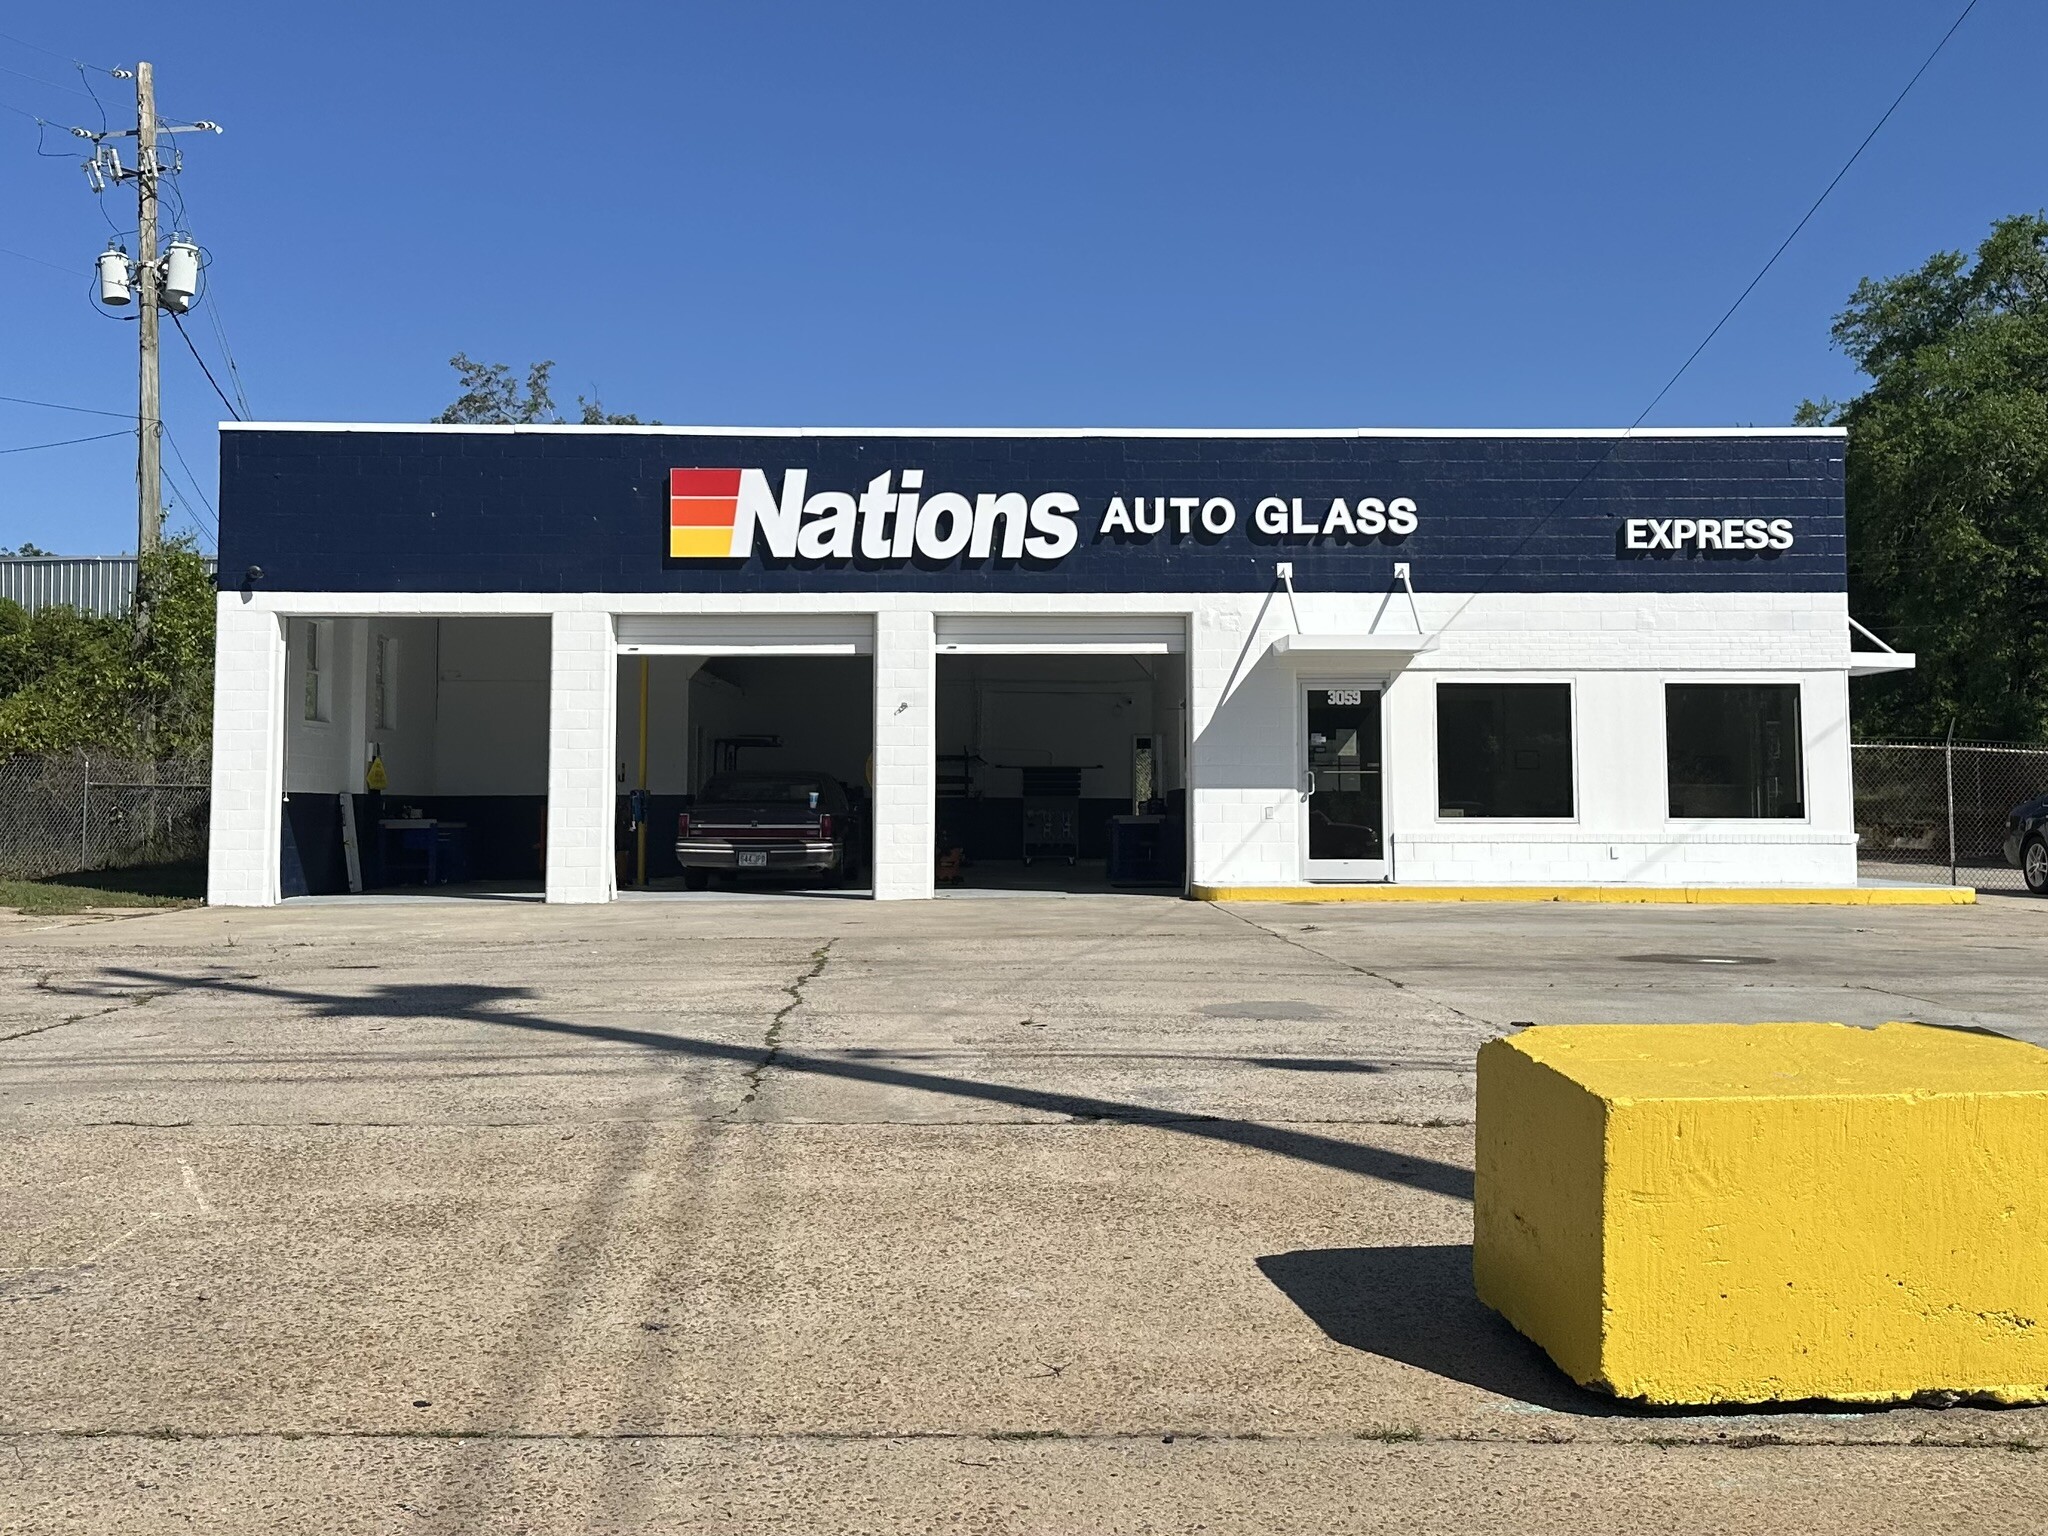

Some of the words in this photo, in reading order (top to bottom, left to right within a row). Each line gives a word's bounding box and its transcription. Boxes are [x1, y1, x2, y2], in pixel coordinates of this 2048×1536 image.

[729, 468, 1080, 560] Nations
[1099, 497, 1236, 535] AUTO
[1255, 497, 1418, 535] GLASS
[1625, 518, 1794, 550] EXPRESS
[1327, 690, 1361, 705] 3059
